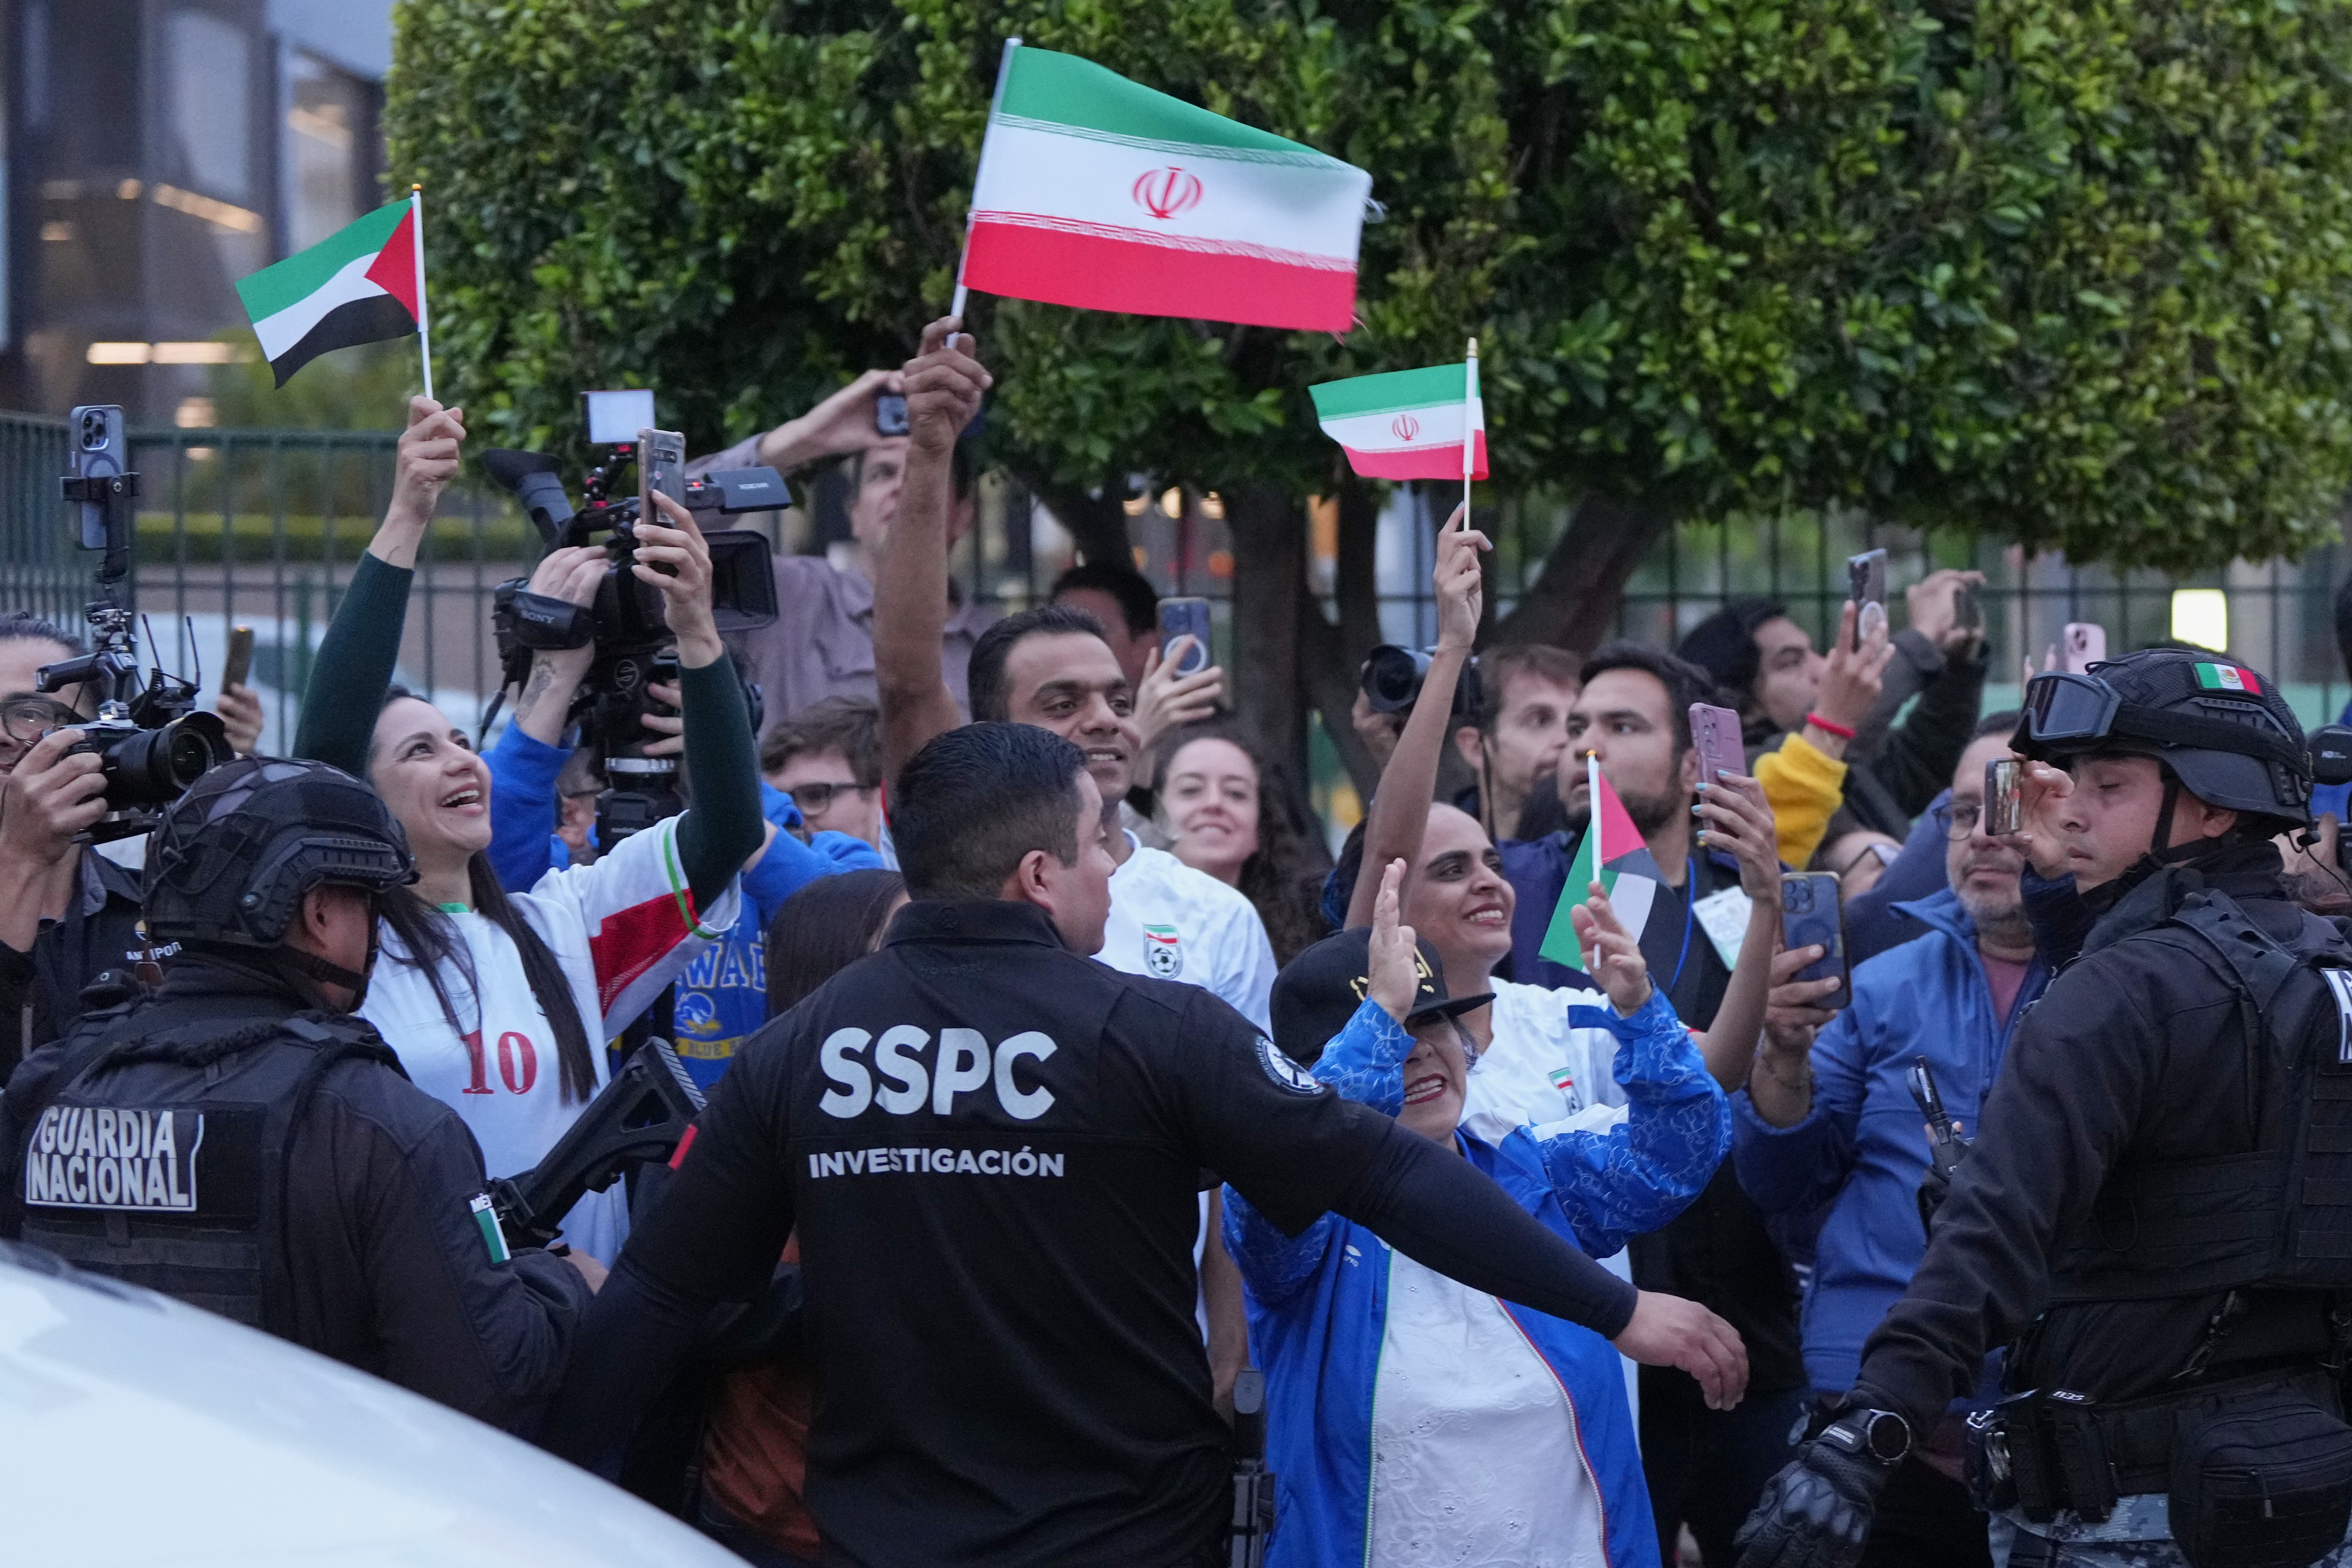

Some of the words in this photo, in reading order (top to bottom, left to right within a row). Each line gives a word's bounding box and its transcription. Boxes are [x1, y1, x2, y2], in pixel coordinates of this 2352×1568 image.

[460, 1029, 538, 1095] 10
[819, 1024, 1058, 1120] SSPC
[39, 1106, 177, 1158] GUARDIA
[31, 1152, 190, 1206] NACIONAL
[808, 1146, 1065, 1178] INVESTIGACIÓN
